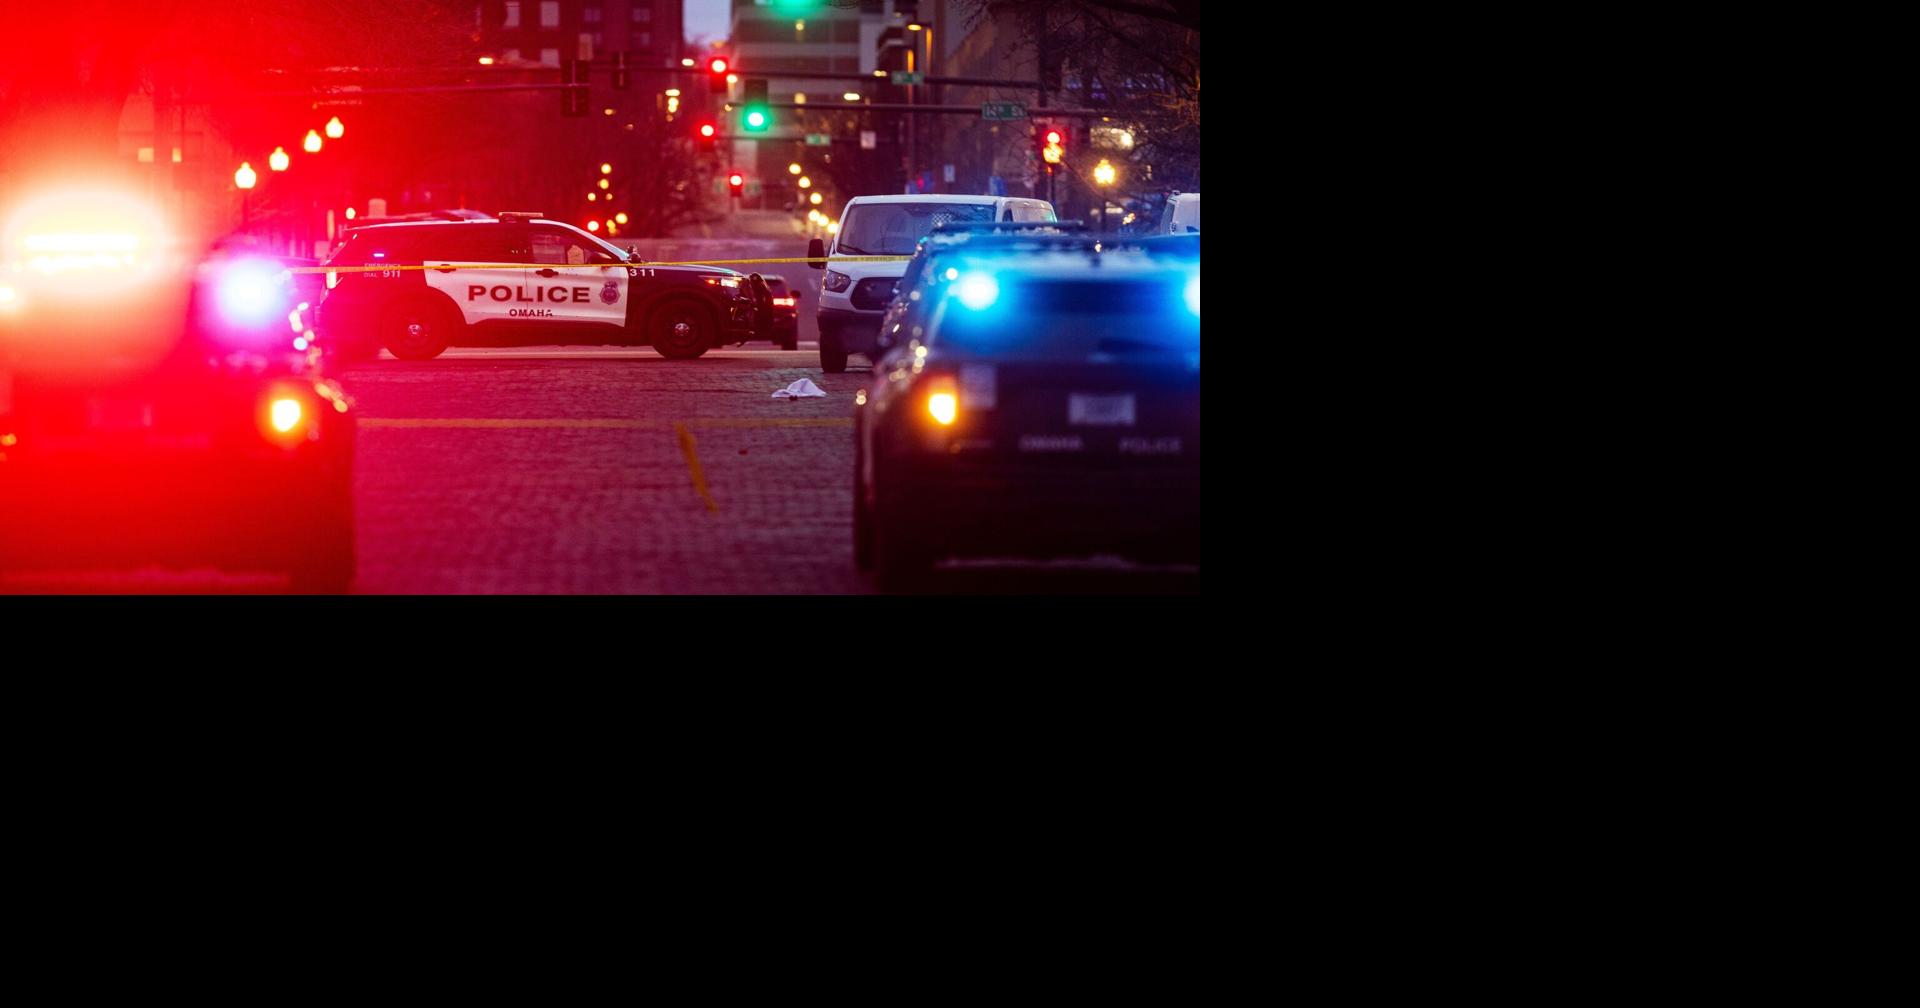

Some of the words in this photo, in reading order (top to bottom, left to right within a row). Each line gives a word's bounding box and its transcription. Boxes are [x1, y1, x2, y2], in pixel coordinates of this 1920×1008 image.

[382, 270, 401, 278] 911
[630, 268, 655, 277] 311
[468, 285, 591, 303] POLICE
[509, 308, 553, 317] OMAHA
